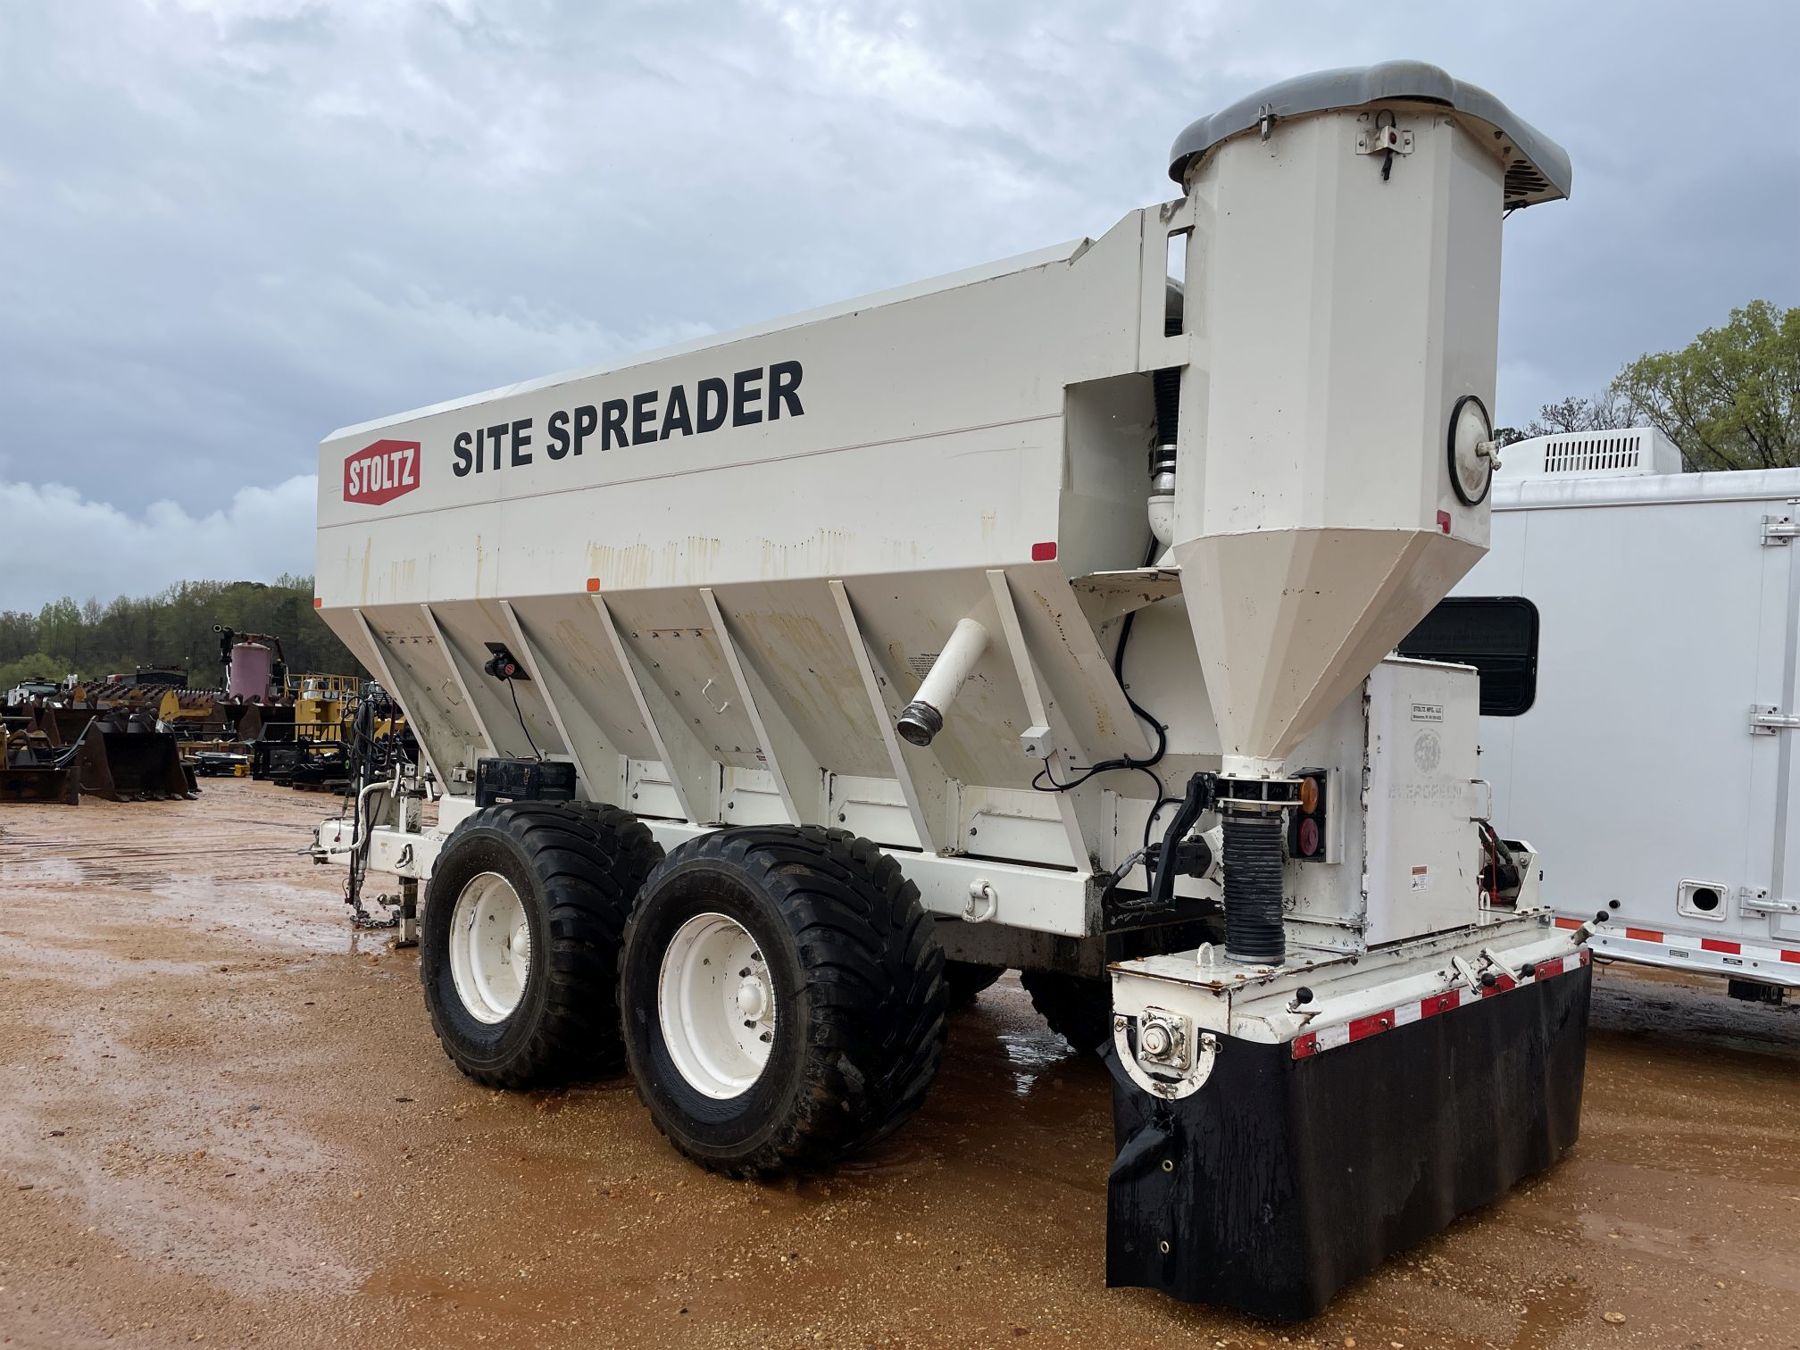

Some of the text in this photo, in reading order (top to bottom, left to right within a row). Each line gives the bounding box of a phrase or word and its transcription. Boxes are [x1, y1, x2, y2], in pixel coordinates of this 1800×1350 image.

[453, 361, 805, 478] SITE SPREADER
[350, 449, 415, 495] STOLTZ
